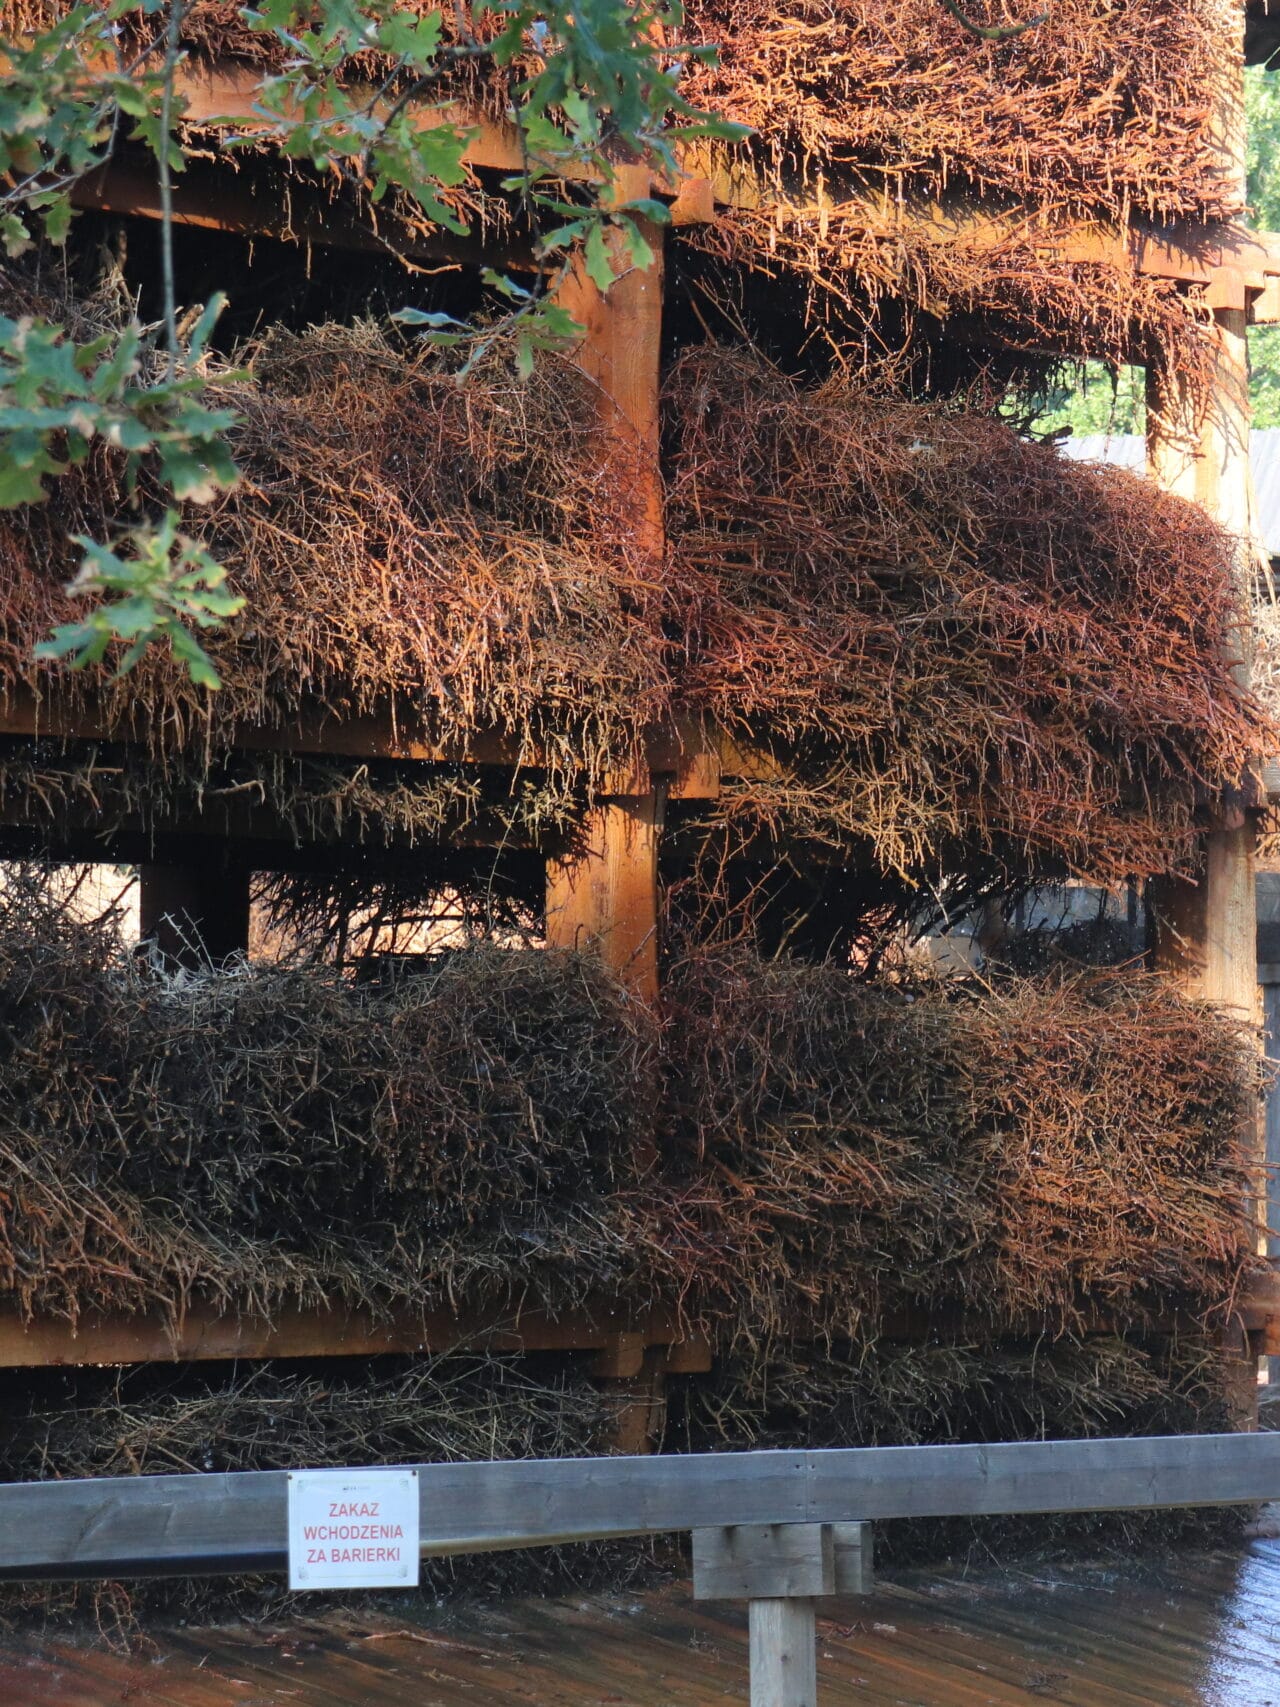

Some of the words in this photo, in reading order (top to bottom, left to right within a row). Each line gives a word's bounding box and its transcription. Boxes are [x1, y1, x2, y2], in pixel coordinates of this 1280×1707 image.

[329, 1502, 380, 1517] ZAKAZ
[304, 1524, 404, 1540] WCHODZENIA
[307, 1549, 327, 1563] ZA
[331, 1547, 400, 1562] BARIERKI
